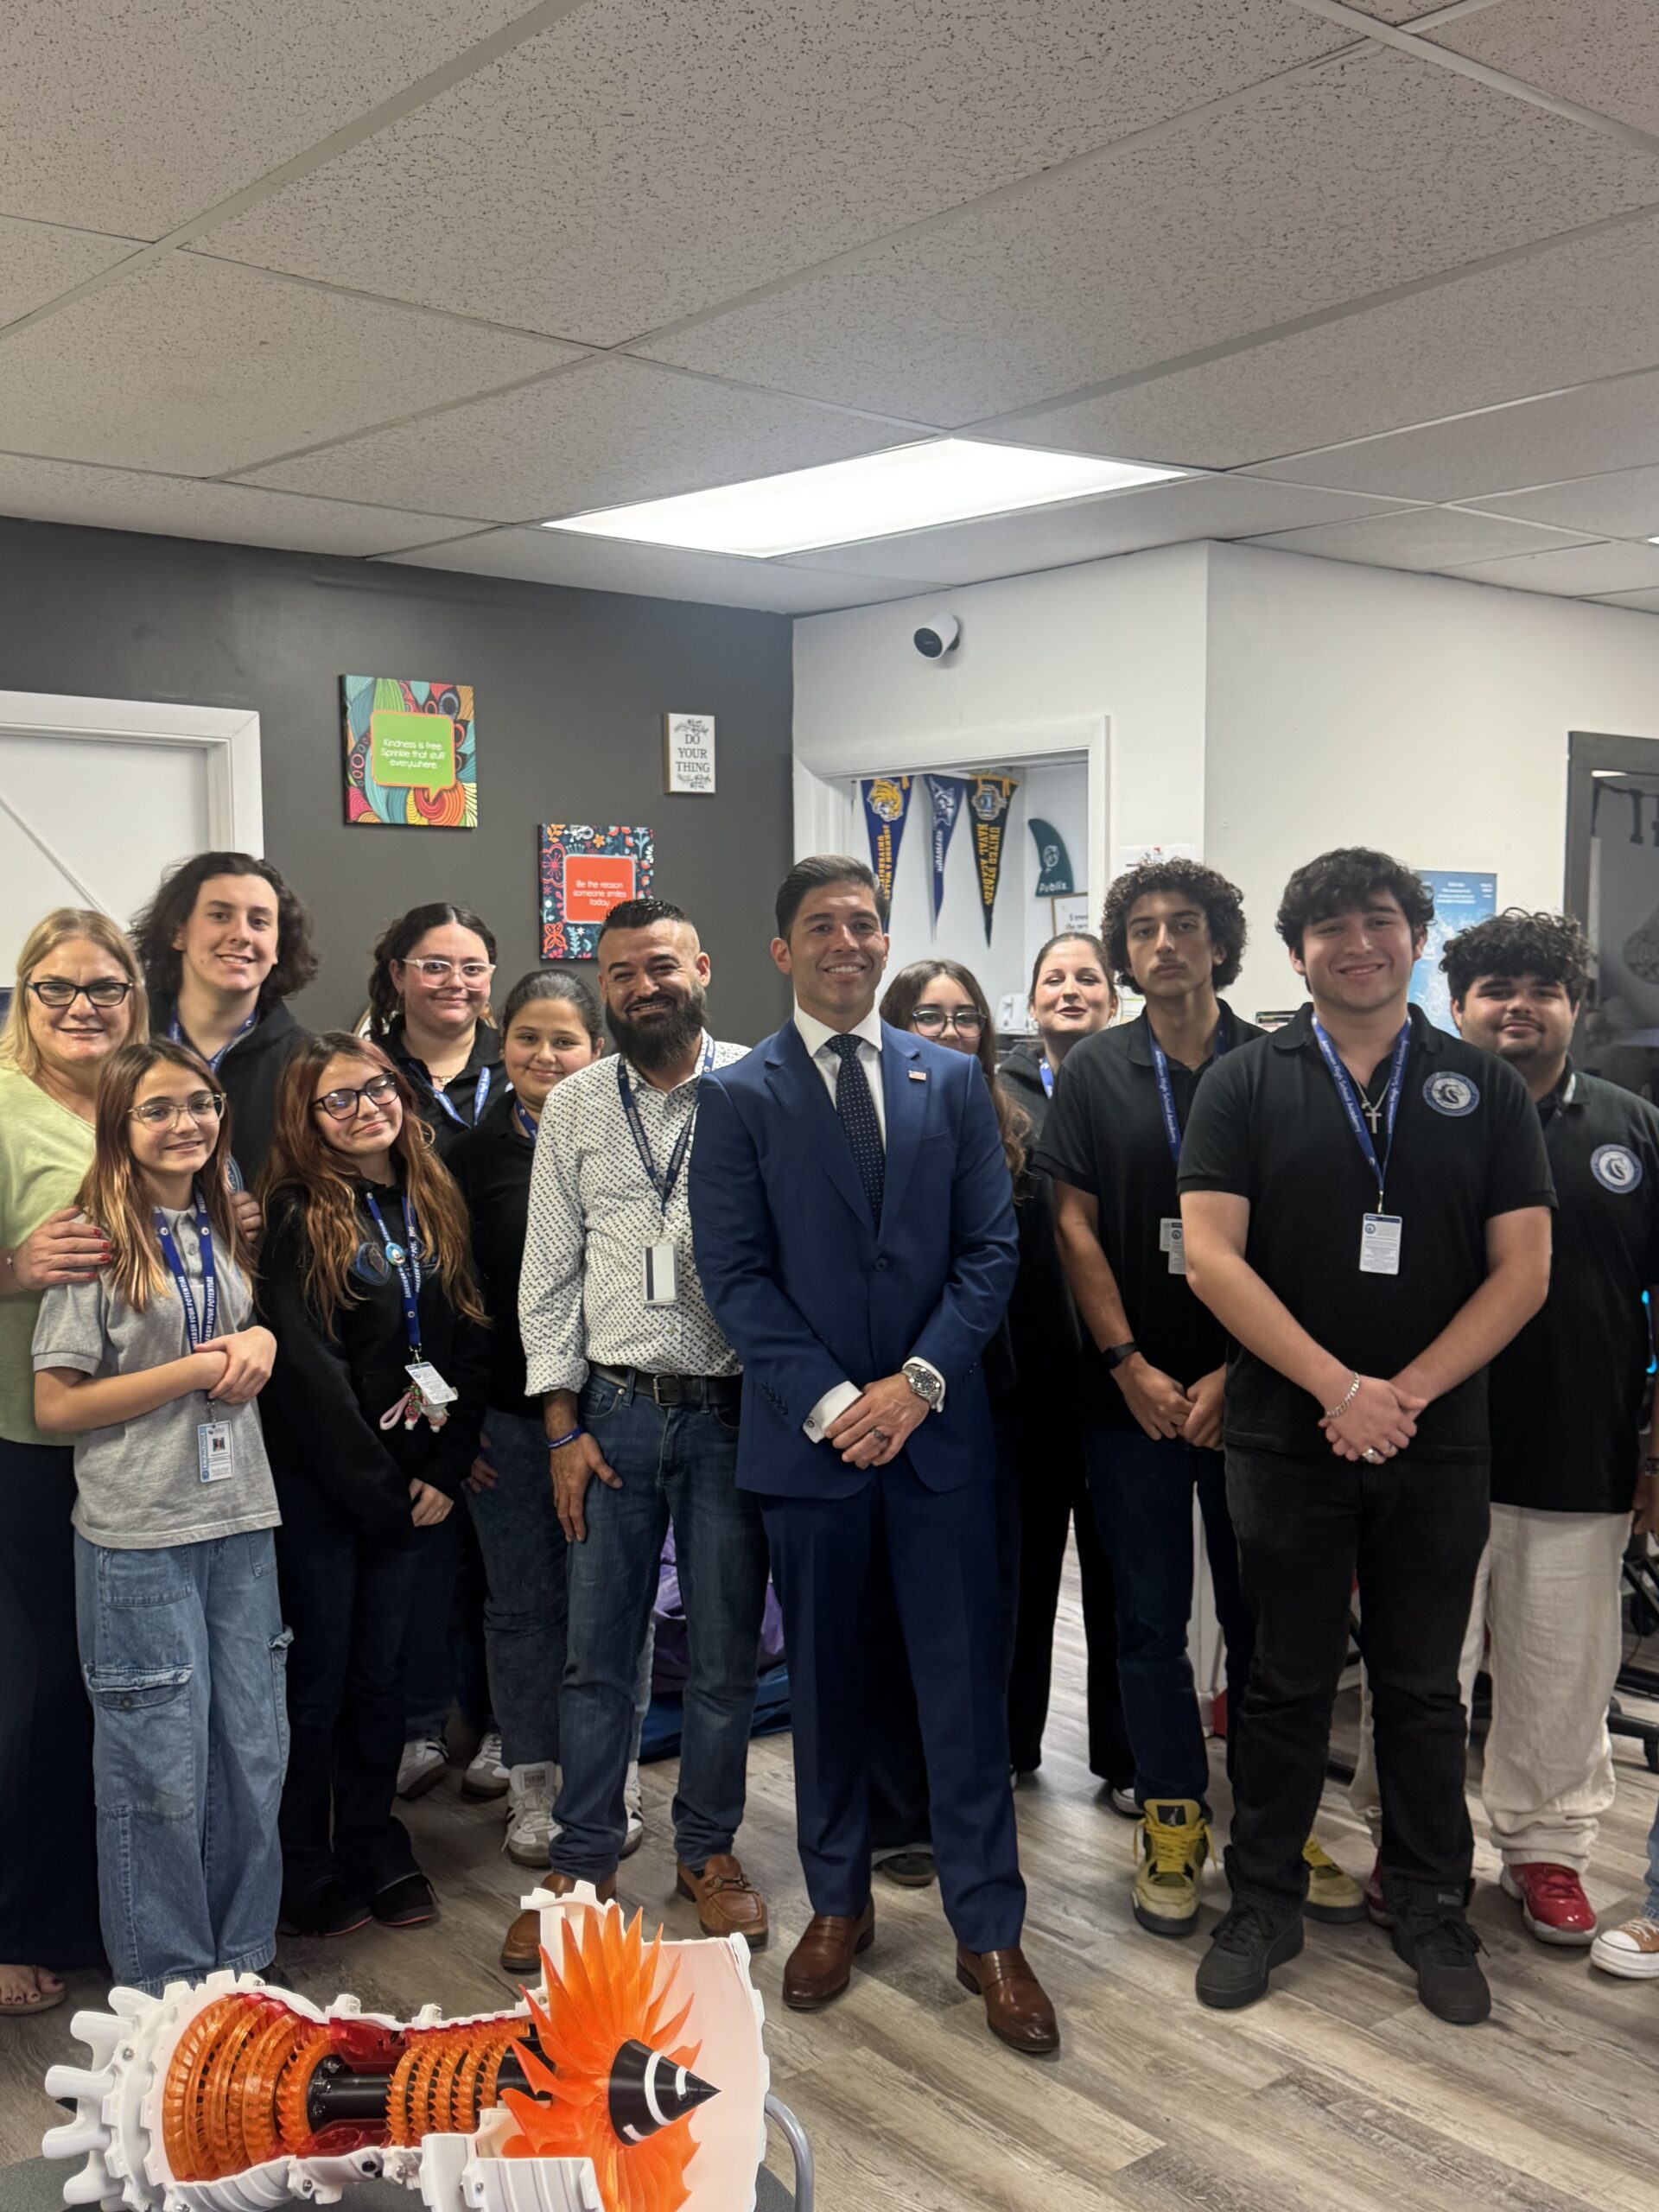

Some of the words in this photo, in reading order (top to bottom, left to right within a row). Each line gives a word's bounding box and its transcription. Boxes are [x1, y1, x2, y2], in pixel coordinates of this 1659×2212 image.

[383, 739, 416, 748] Kindness
[685, 734, 701, 745] DO
[380, 747, 411, 759] Sprinkle
[412, 750, 428, 759] that
[677, 747, 708, 760] YOUR
[675, 761, 710, 773] THING
[882, 824, 892, 862] JOHNSON
[976, 823, 989, 855] NAVAL
[988, 827, 1001, 864] UNITED
[576, 880, 586, 888] Be
[1338, 1080, 1352, 1102] School
[177, 1276, 193, 1306] POTENTIAL
[207, 1276, 215, 1306] POTENTIAL
[188, 1307, 196, 1323] YOUR
